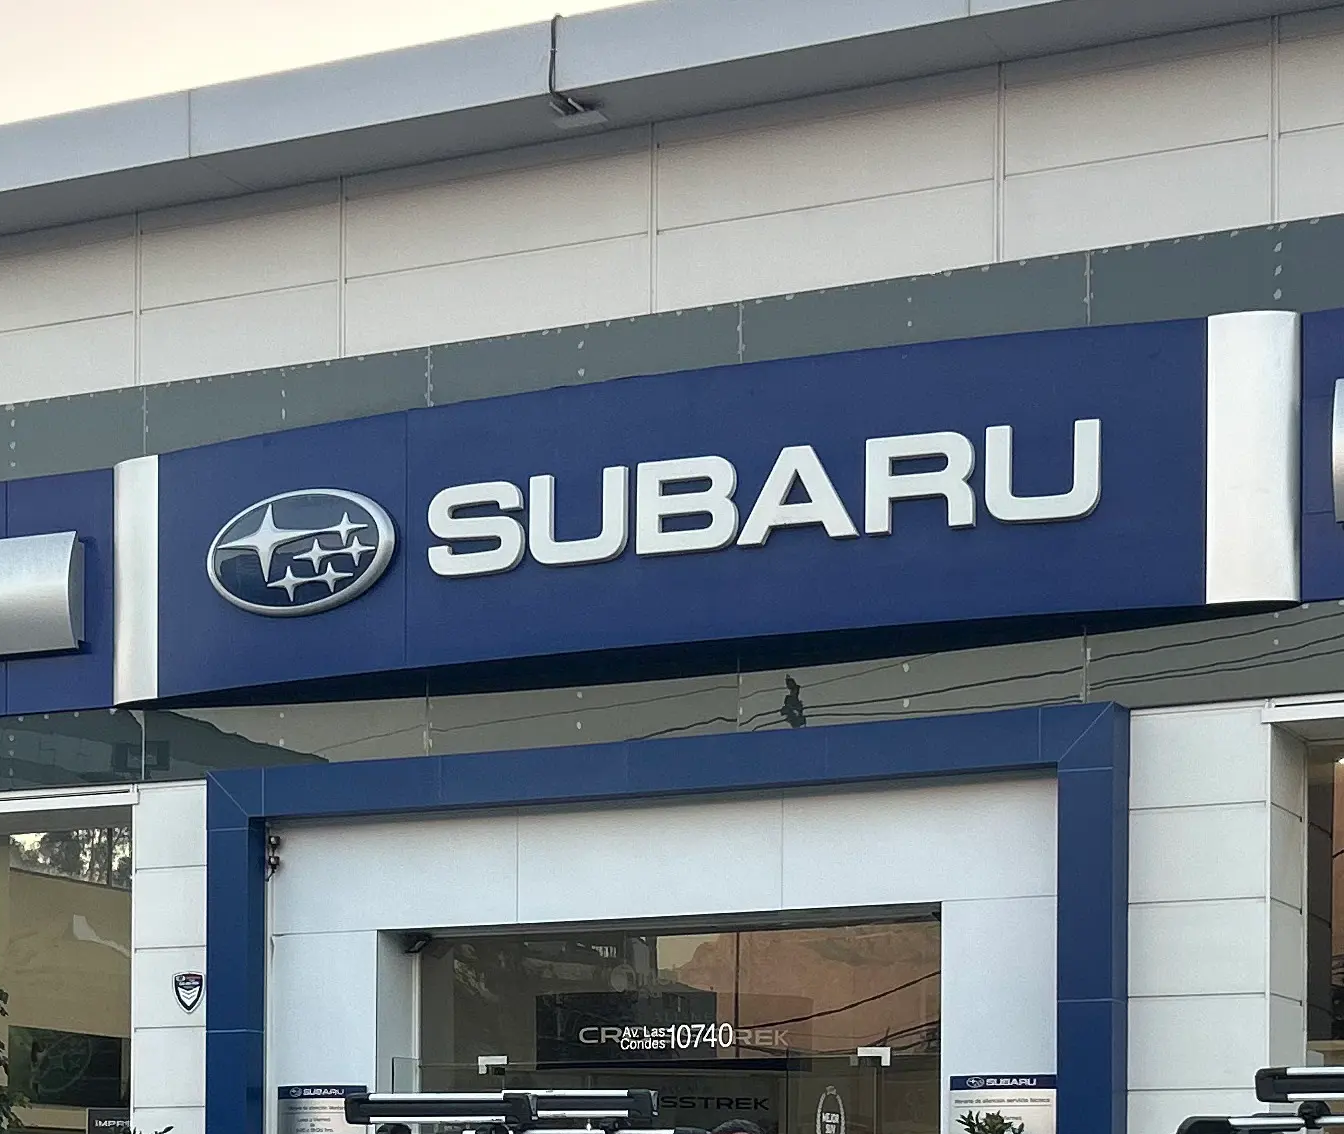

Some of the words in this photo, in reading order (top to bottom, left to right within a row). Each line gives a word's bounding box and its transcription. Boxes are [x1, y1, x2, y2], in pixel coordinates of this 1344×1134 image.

[427, 418, 1102, 577] SUBARU
[622, 1027, 640, 1038] Av.
[644, 1026, 666, 1038] Las
[667, 1022, 733, 1049] 10740
[620, 1038, 666, 1050] Condes
[985, 1078, 1037, 1087] SUBARU
[302, 1087, 345, 1096] SUBARU
